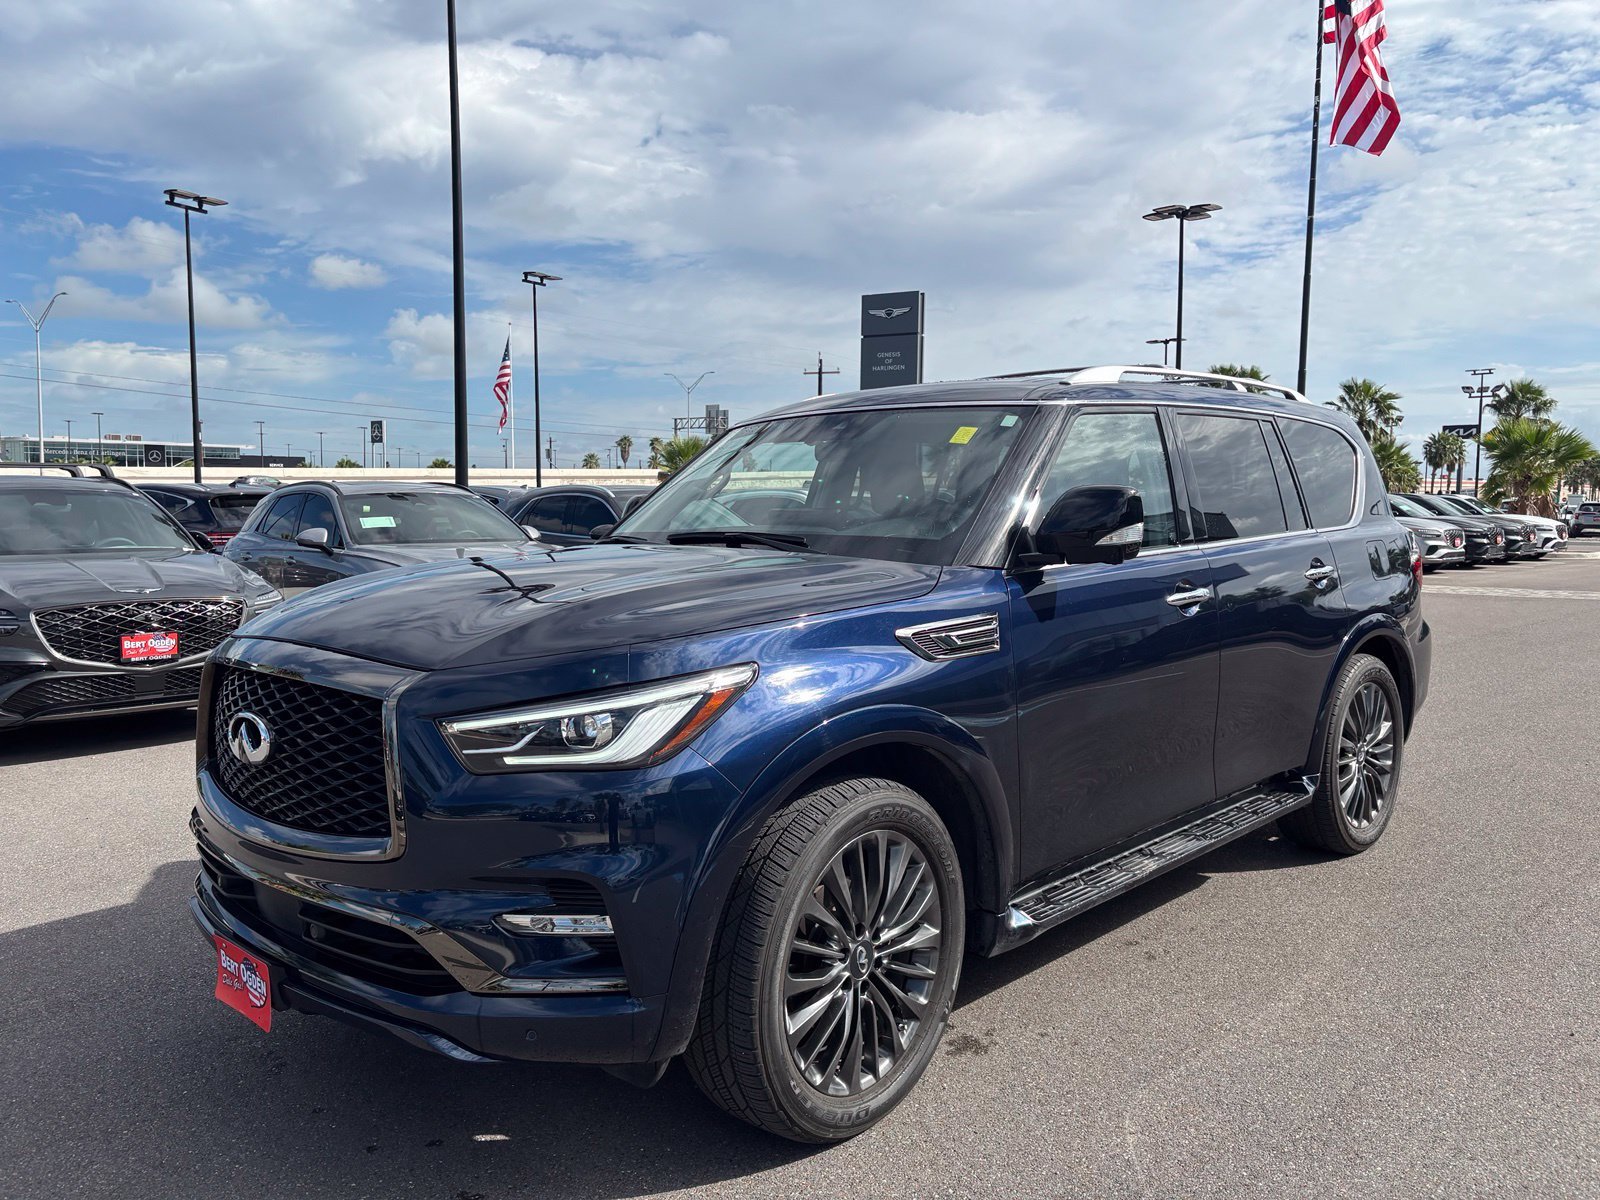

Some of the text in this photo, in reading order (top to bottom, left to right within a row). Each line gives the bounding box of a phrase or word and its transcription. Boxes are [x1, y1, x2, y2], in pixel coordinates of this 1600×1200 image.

[124, 638, 176, 648] BERT OGDEN
[220, 949, 266, 996] BERT OGDEN
